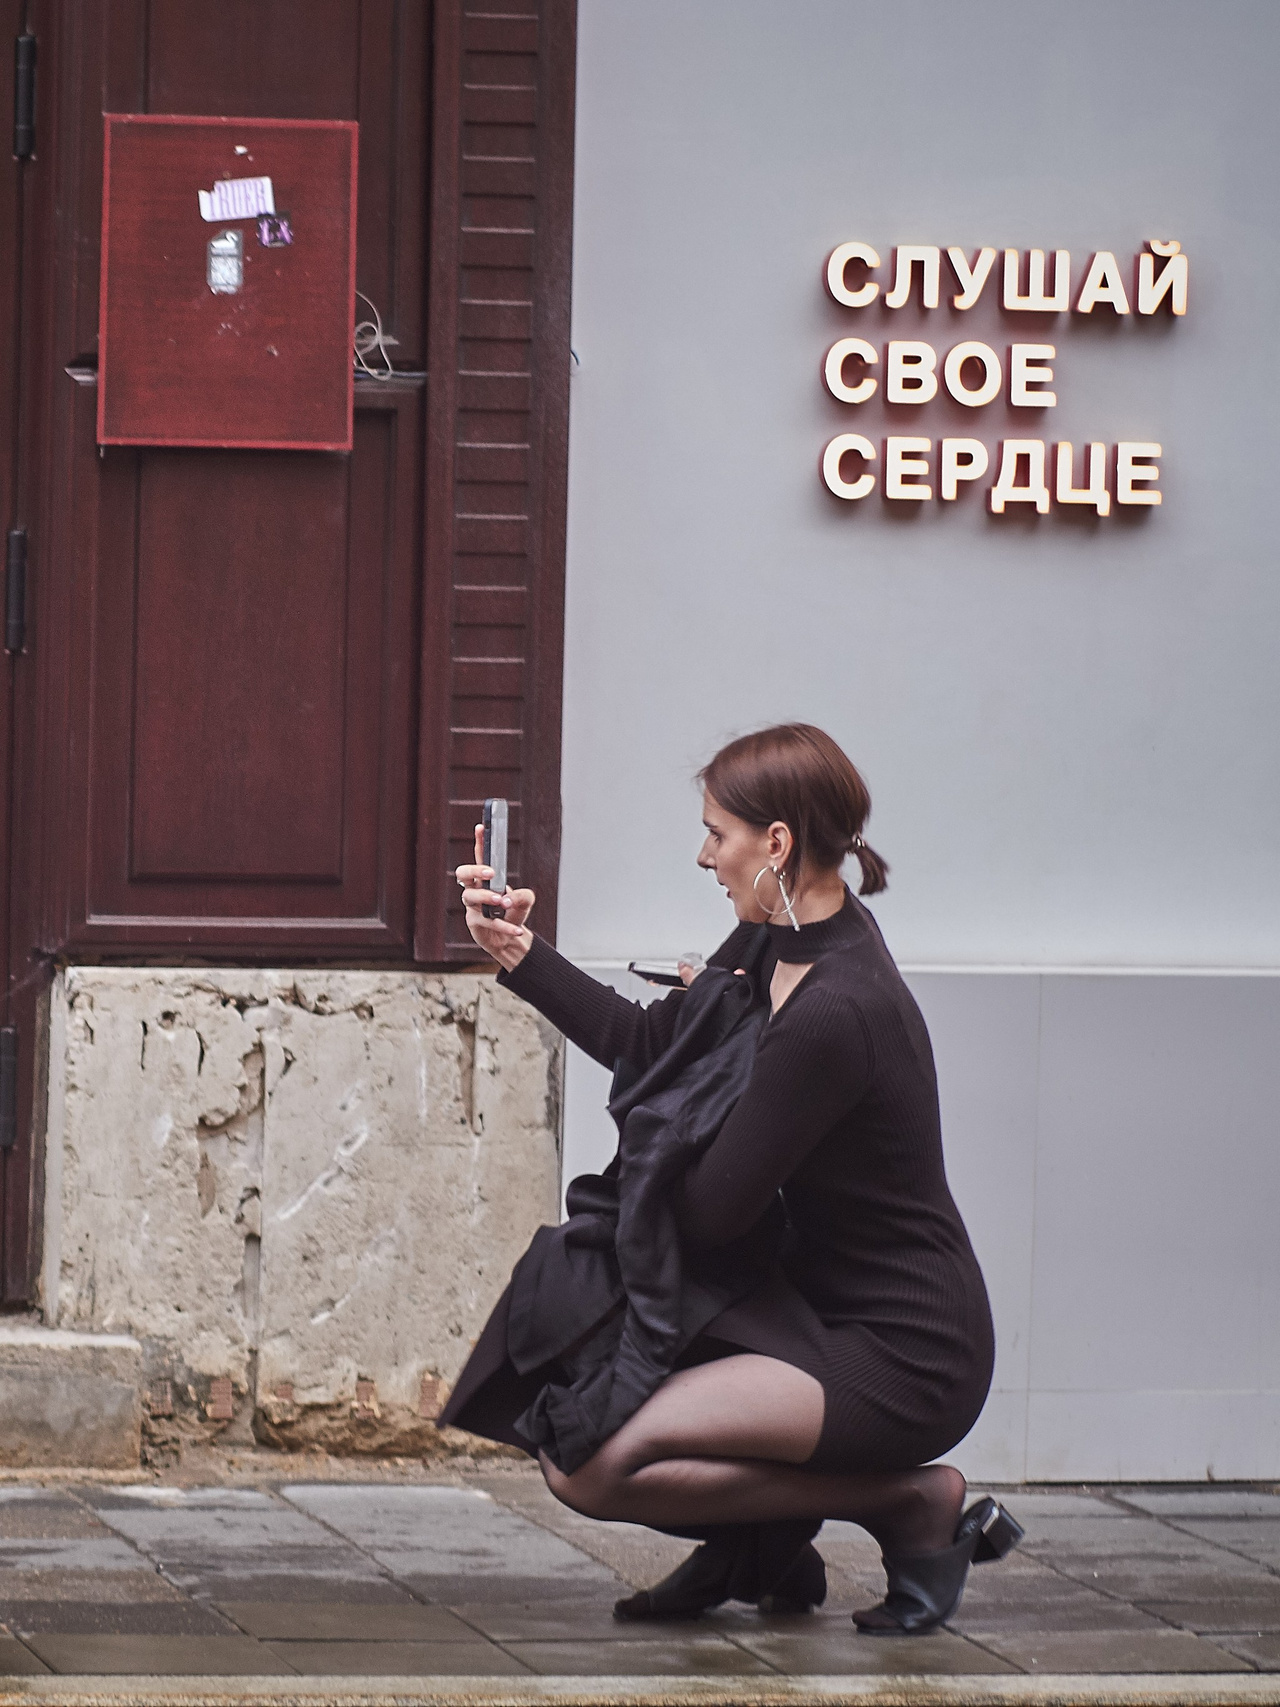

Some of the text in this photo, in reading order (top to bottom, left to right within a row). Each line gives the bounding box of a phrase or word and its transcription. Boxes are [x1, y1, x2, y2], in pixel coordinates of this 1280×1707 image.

[826, 239, 1188, 316] СЛУШАЙ
[824, 337, 1057, 408] СВОЕ
[822, 433, 1162, 517] СЕРДЦЕ
